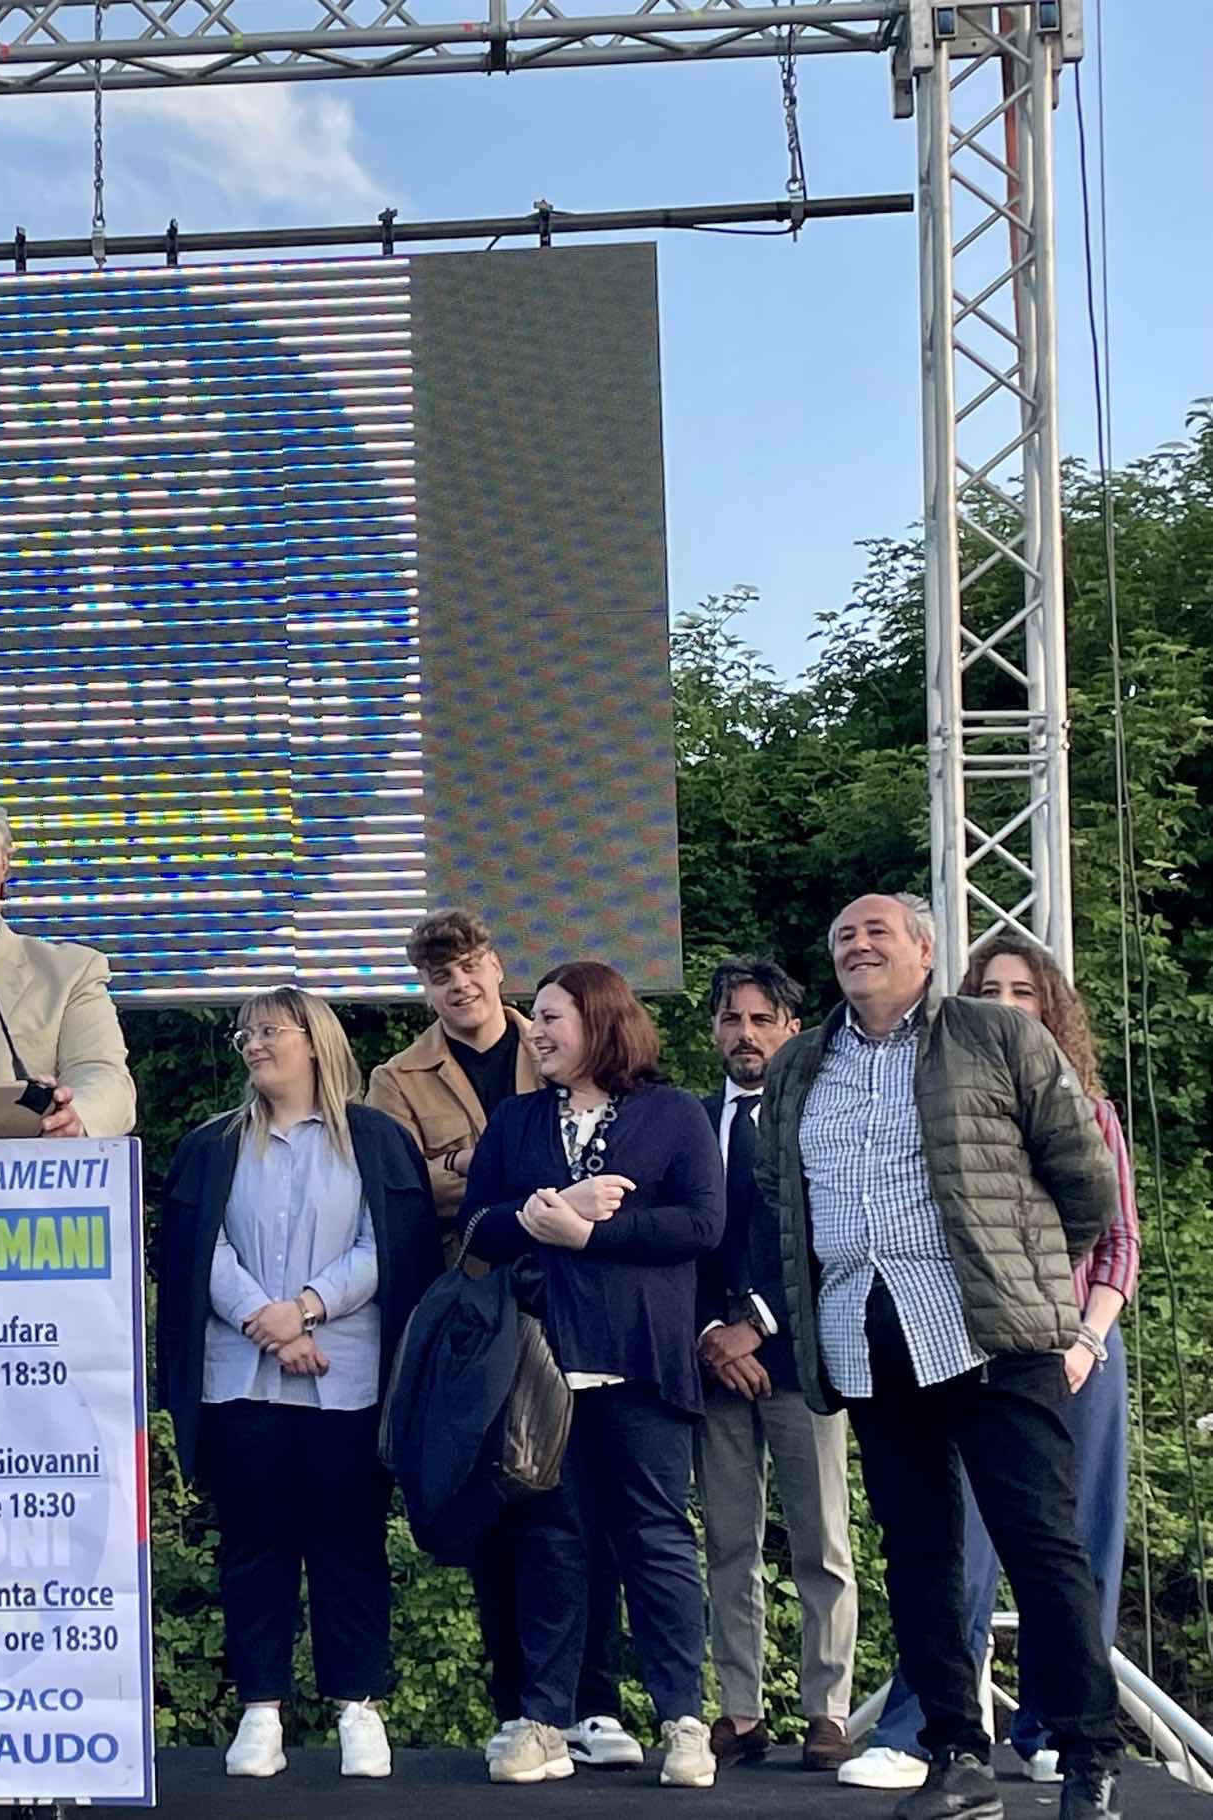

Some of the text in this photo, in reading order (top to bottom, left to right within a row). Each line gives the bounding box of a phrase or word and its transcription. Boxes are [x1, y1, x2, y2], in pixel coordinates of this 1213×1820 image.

[0, 1360, 68, 1387] 18:30
[9, 1493, 77, 1519] 18:30
[43, 1580, 115, 1607] Croce
[4, 1629, 45, 1651] ore
[51, 1625, 119, 1651] 18:30
